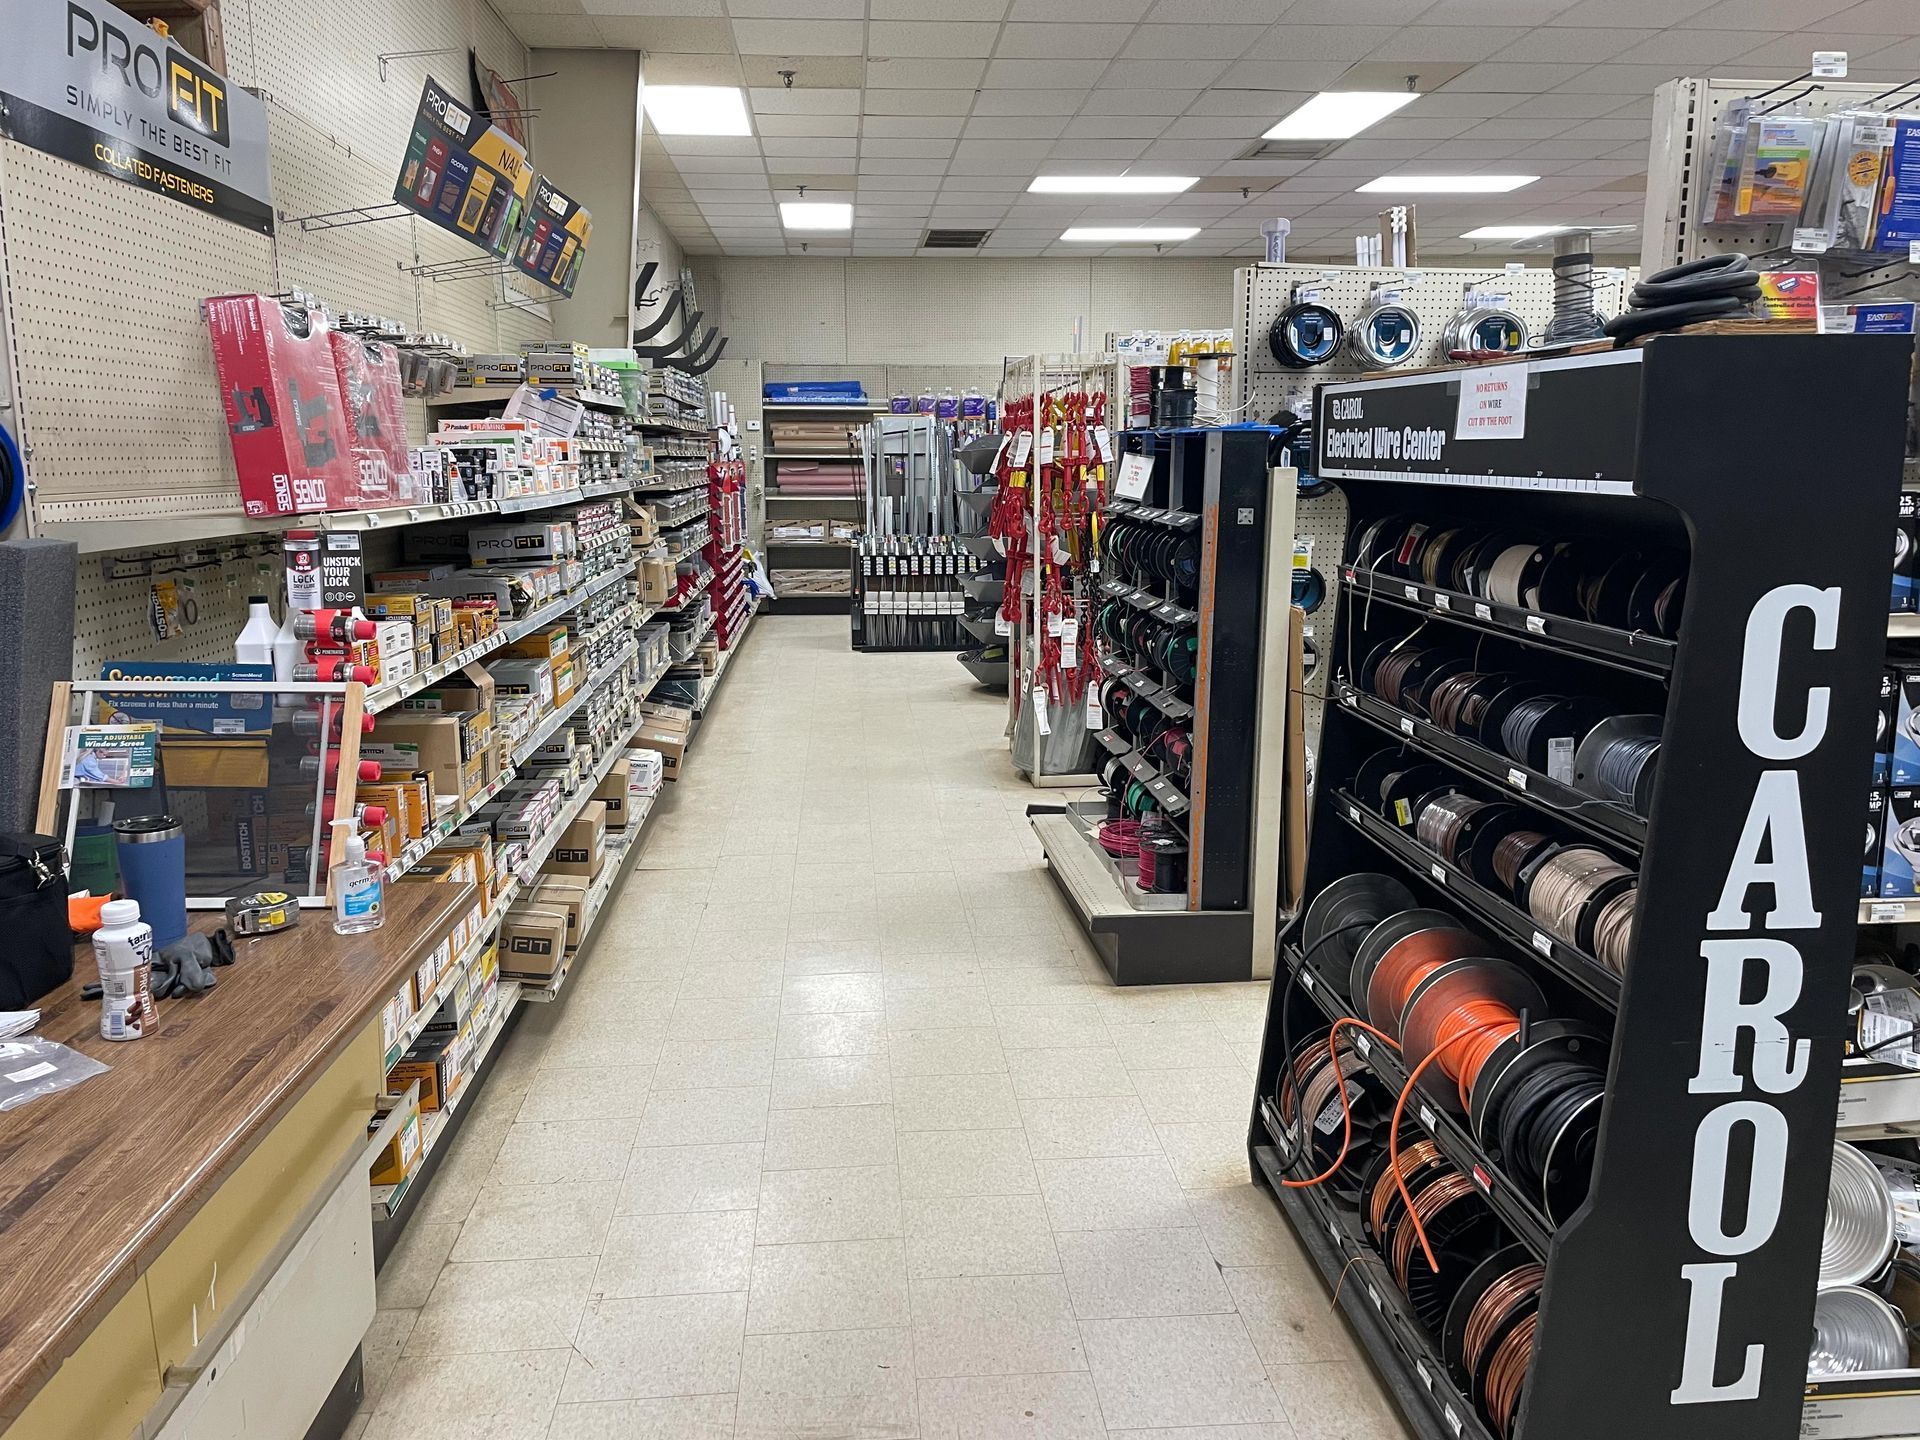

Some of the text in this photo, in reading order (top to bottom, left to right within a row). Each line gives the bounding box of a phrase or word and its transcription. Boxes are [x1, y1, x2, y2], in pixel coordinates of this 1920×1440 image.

[67, 1, 223, 132] PROFIT
[67, 85, 232, 176] SIMPLY THE BEST FIT
[94, 143, 215, 204] COLLATED FASTENERS
[476, 364, 518, 372] PROFIT
[530, 364, 570, 372] PROFIT
[1476, 381, 1508, 392] NO RETURNS
[1341, 397, 1364, 420] CAROL
[1479, 399, 1502, 409] ON WIRE
[1468, 415, 1512, 426] CUT BY THE FOOT
[1326, 425, 1446, 460] Electrical Wire Center
[360, 459, 388, 486] SENCO
[272, 474, 290, 512] SENCO
[293, 479, 327, 504] SENCO
[477, 535, 542, 549] PROFIT
[323, 556, 361, 567] UNSTICK
[293, 574, 315, 584] LOCK
[323, 567, 350, 577] YOUR
[324, 577, 350, 587] LOCK
[148, 700, 155, 708] in
[172, 701, 188, 709] than
[195, 701, 219, 709] minute
[239, 821, 252, 870] BOSTITCH
[1669, 583, 1843, 1404] CAROL
